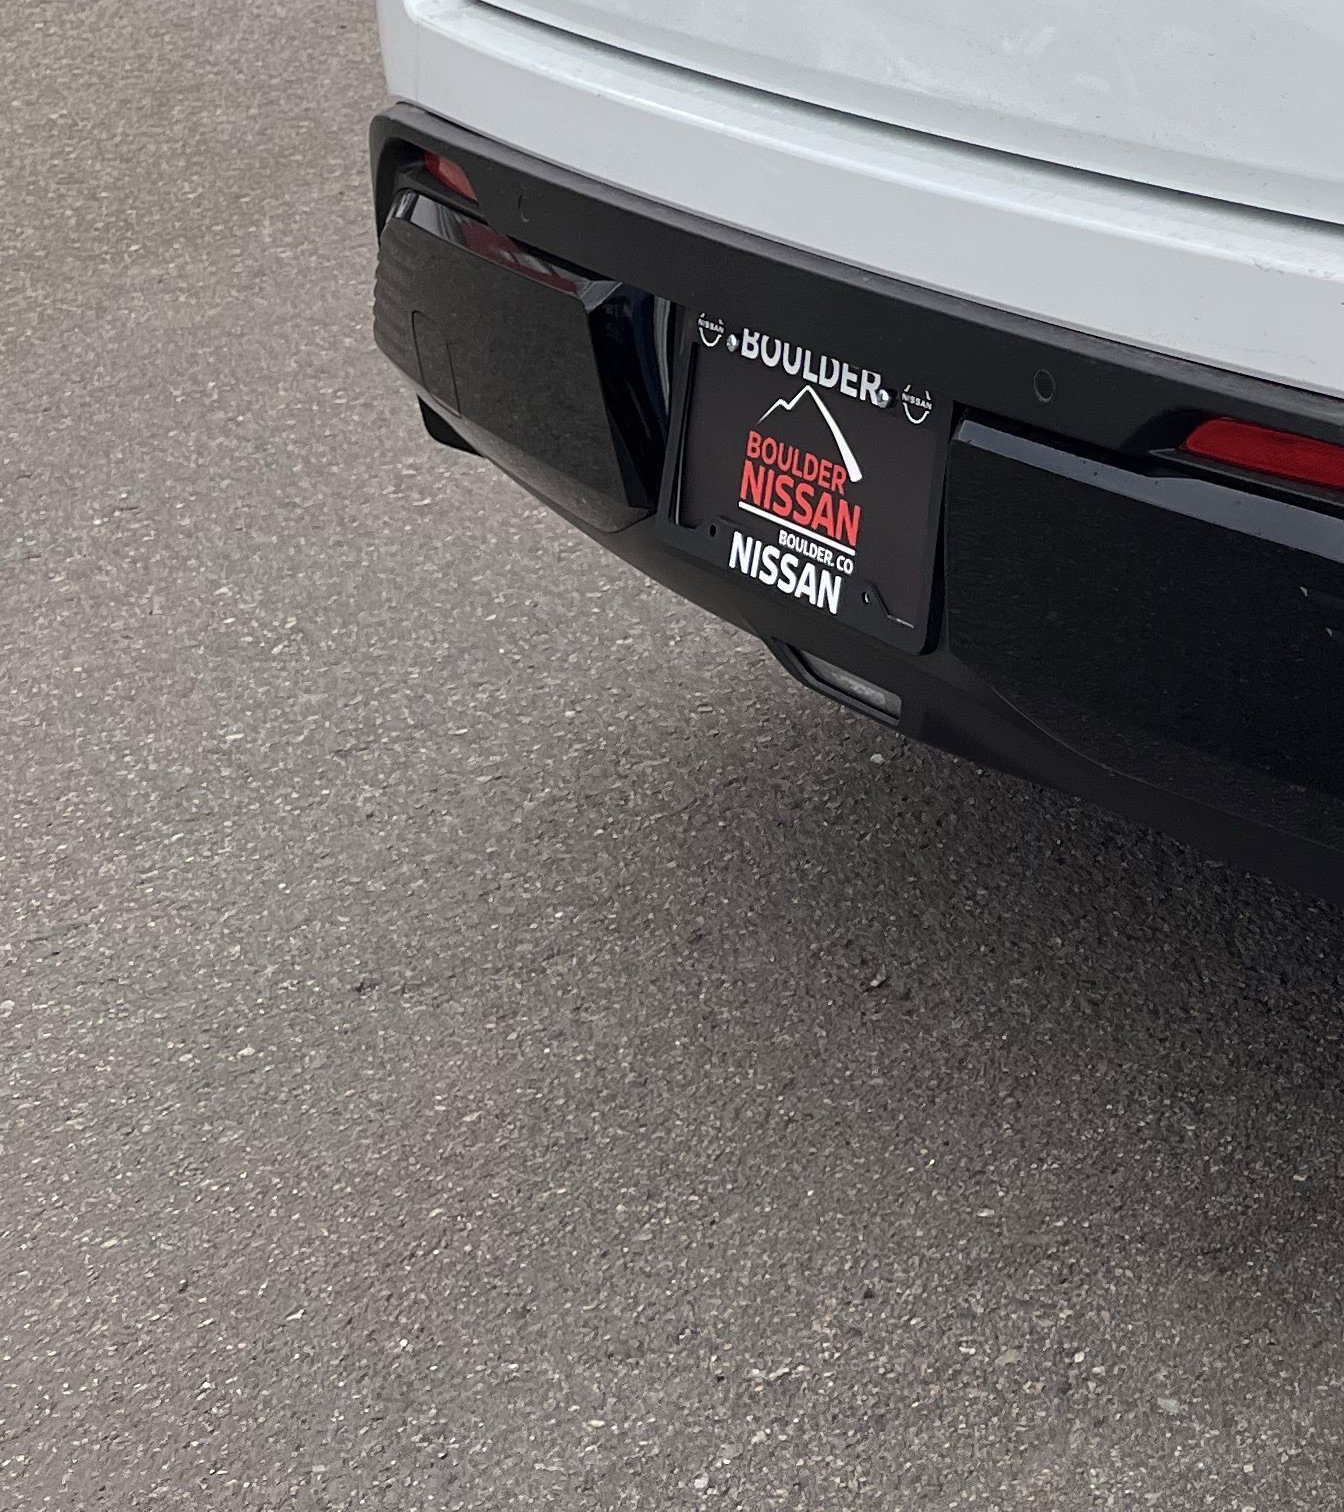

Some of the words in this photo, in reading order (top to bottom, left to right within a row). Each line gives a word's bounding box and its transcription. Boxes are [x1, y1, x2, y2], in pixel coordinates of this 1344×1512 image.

[741, 327, 882, 406] BOULDER
[746, 430, 847, 495] BOULDER
[739, 460, 862, 547] NISSAN
[729, 531, 842, 615] NISSAN
[836, 555, 854, 574] CO
